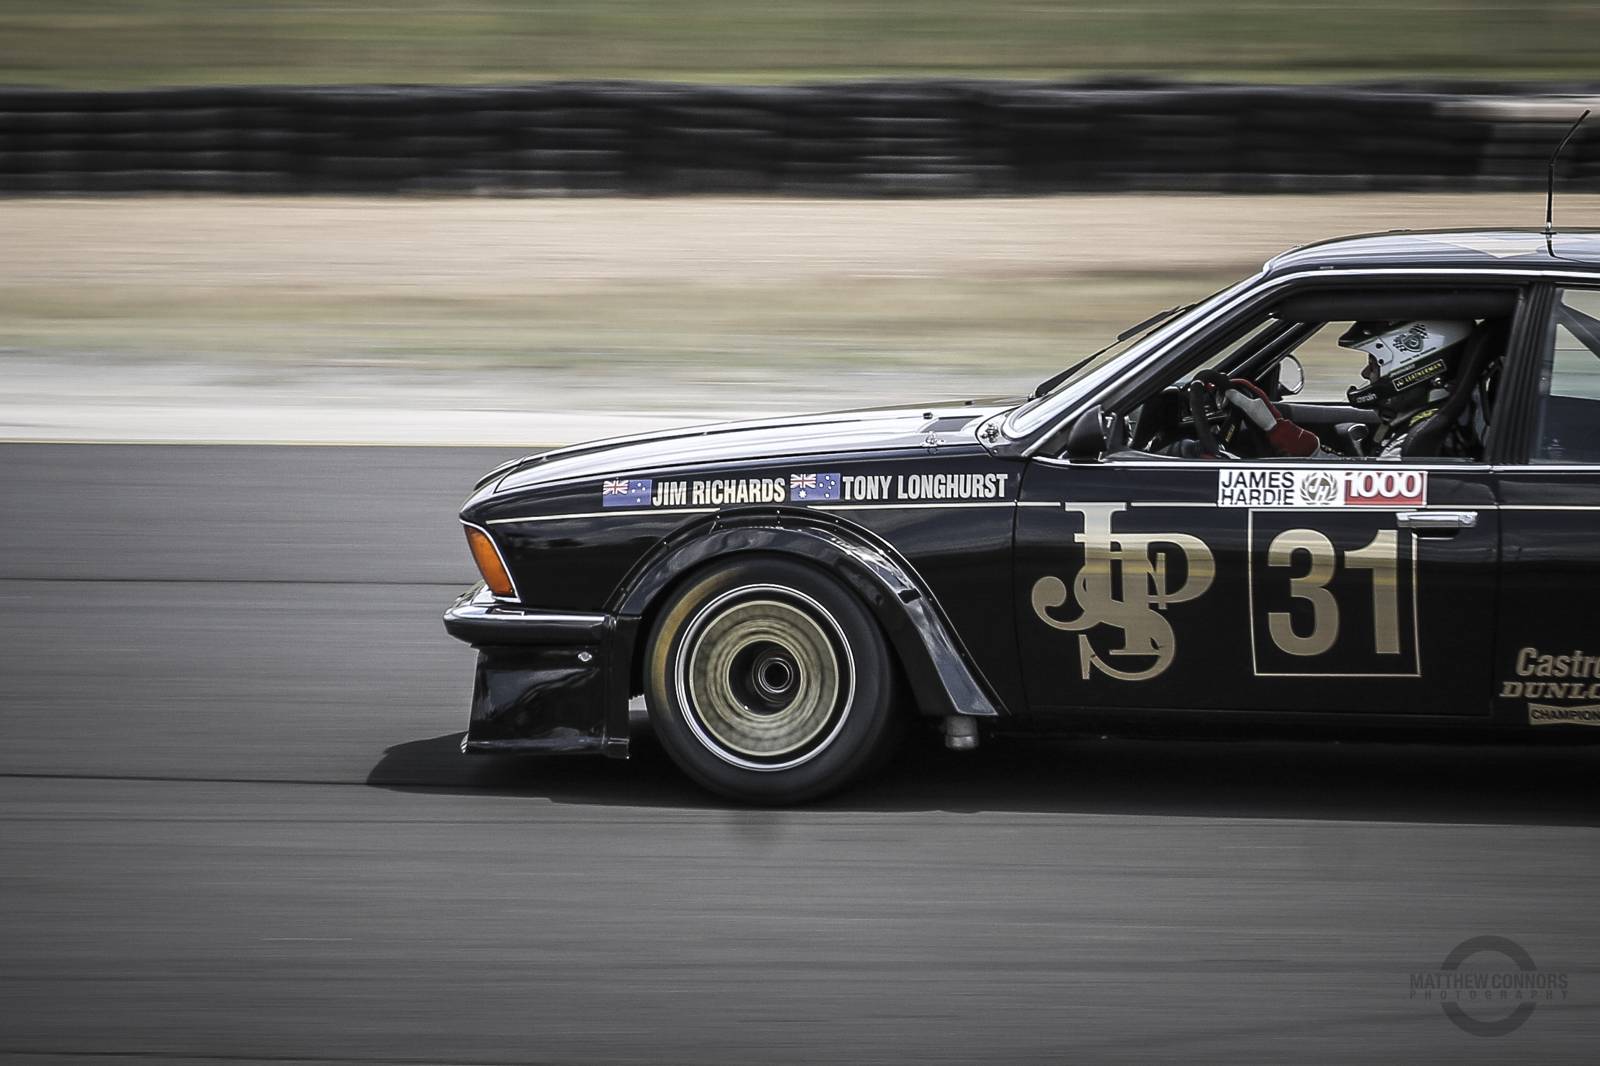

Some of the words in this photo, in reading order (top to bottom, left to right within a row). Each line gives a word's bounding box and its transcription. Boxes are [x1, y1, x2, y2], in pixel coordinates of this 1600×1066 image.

[651, 482, 689, 507] JIM
[692, 477, 786, 506] RICHARDS
[842, 475, 893, 501] TONY
[897, 473, 1008, 499] LONGHURST
[1221, 471, 1295, 488] JAMES
[1345, 471, 1423, 498] 1000
[1221, 489, 1295, 506] HARDIE
[1267, 528, 1401, 657] 31
